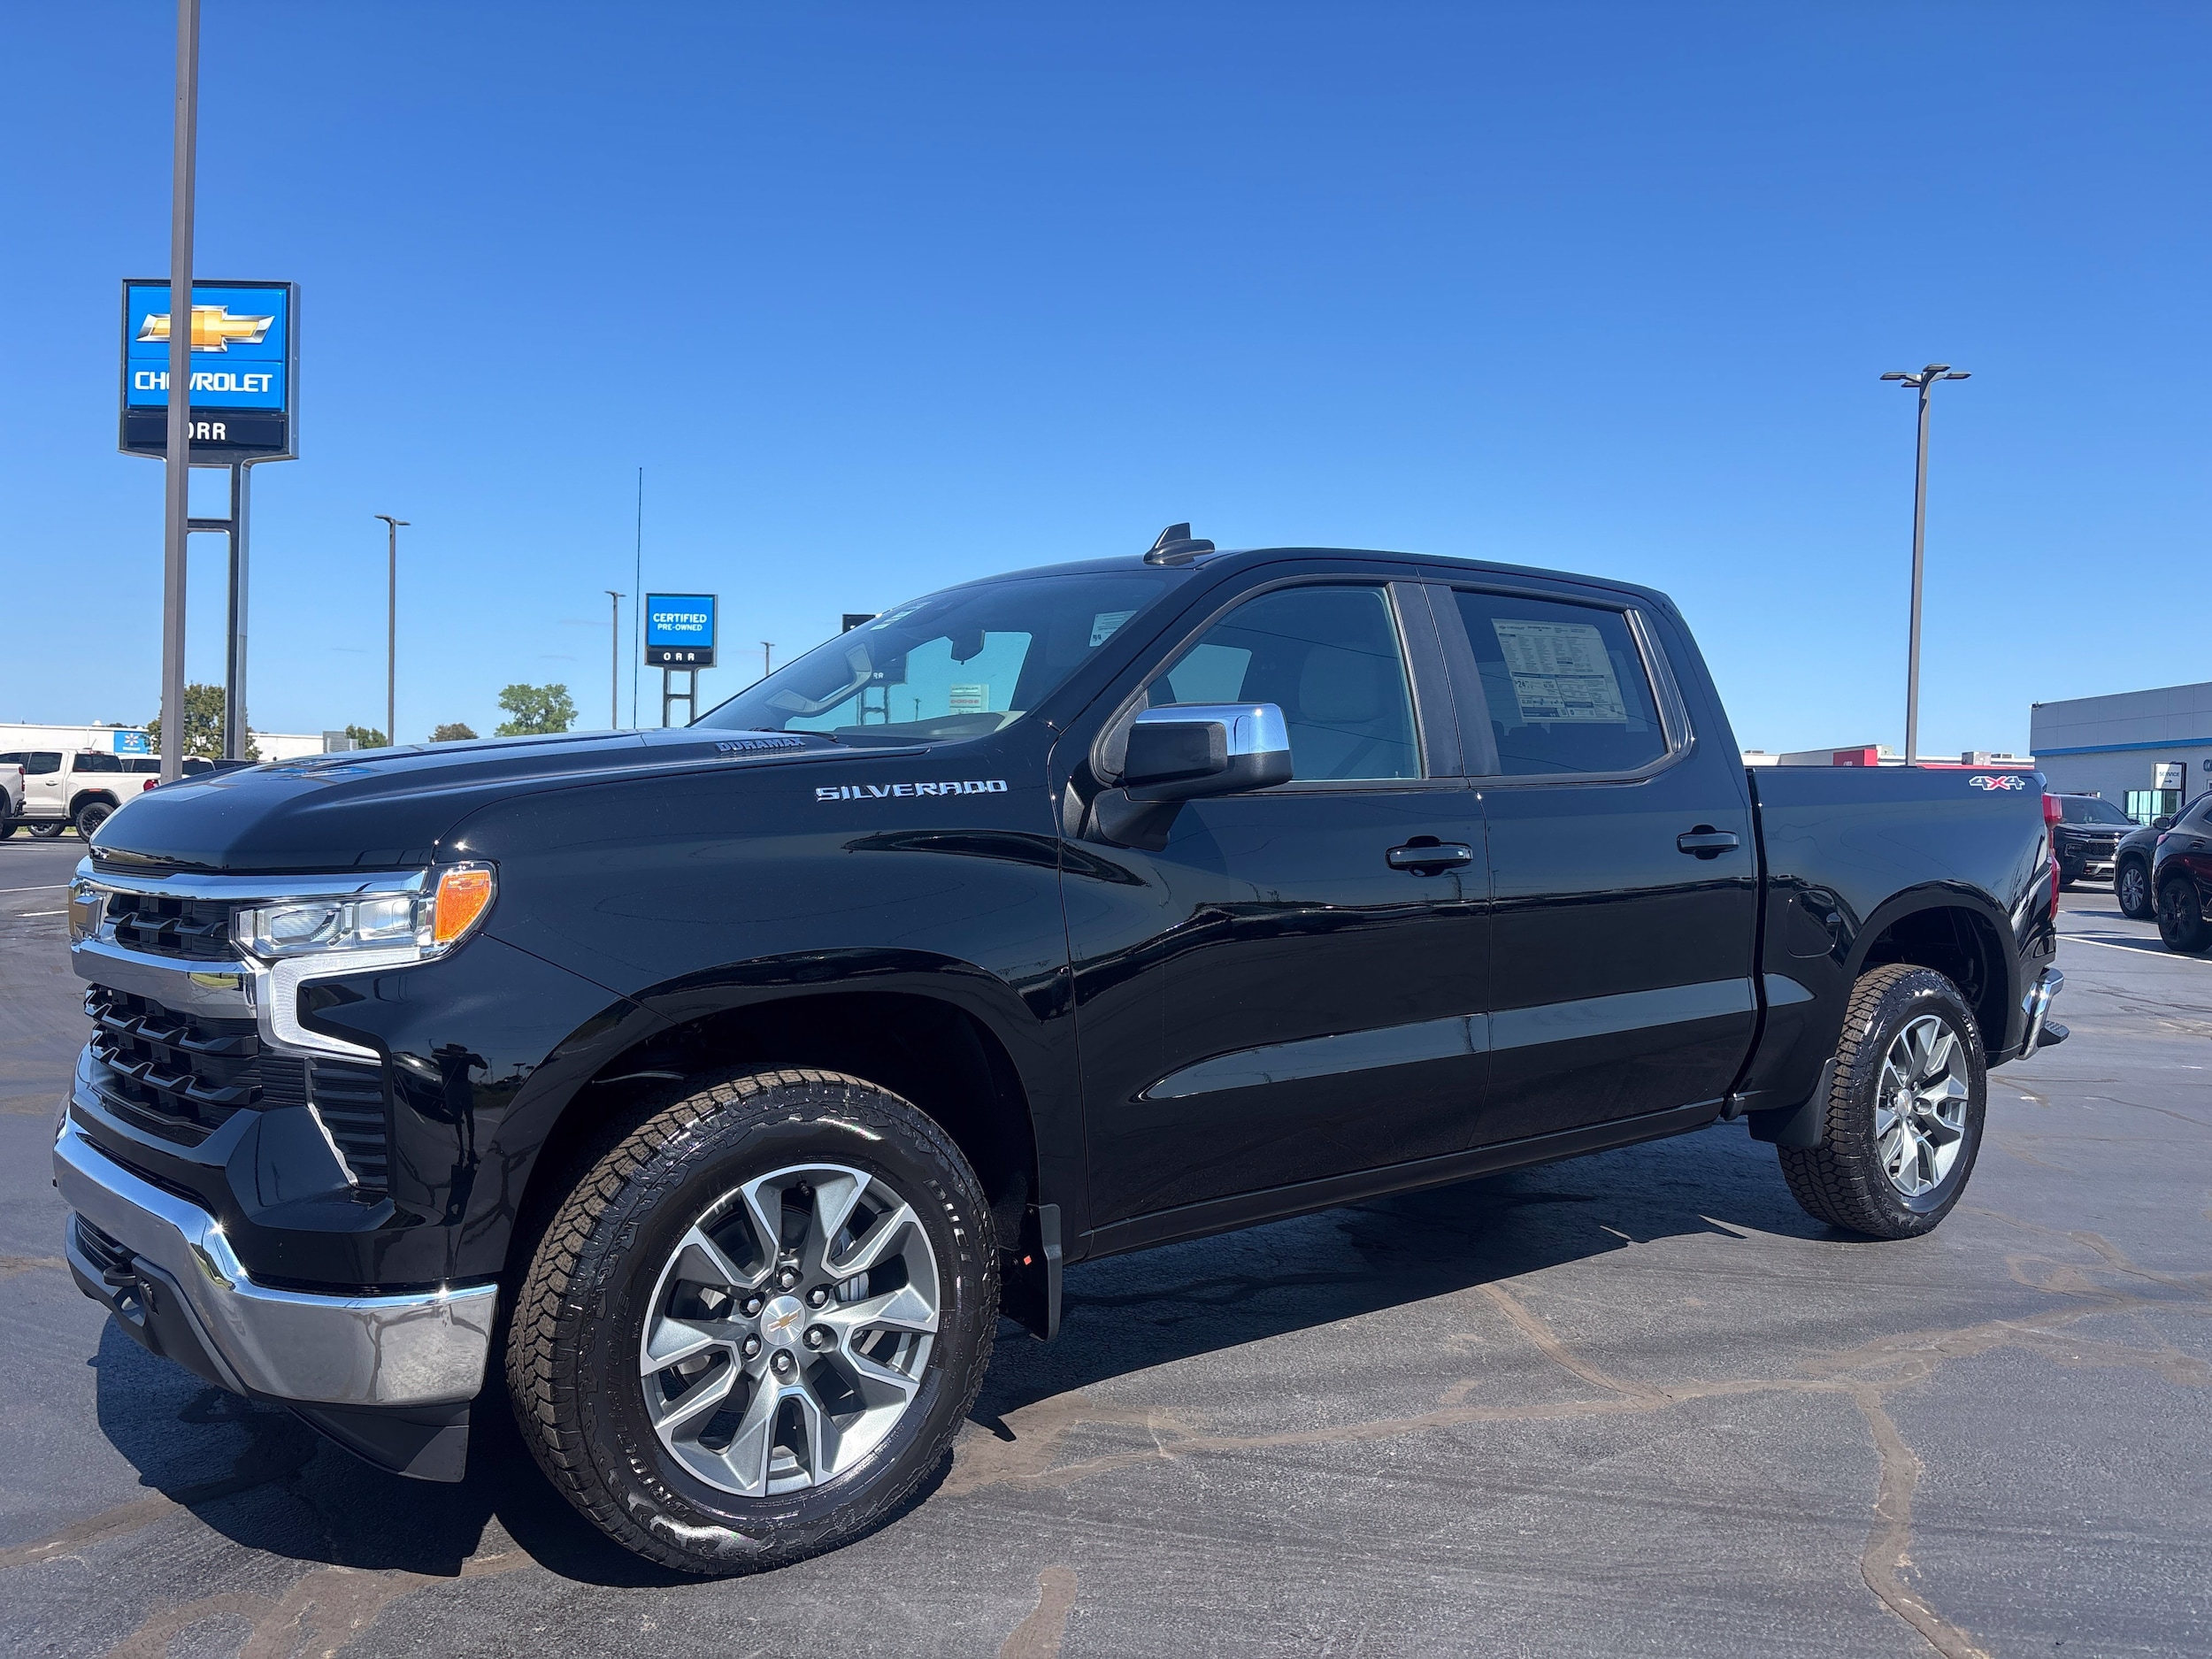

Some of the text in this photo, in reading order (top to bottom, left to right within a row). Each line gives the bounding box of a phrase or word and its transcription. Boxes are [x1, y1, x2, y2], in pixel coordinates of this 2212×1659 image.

[134, 371, 273, 393] CHVROLET
[653, 613, 707, 623] CERTIFIED
[664, 652, 695, 661] ORR
[715, 738, 806, 752] DURAMAX
[816, 780, 1008, 803] SILVERADO
